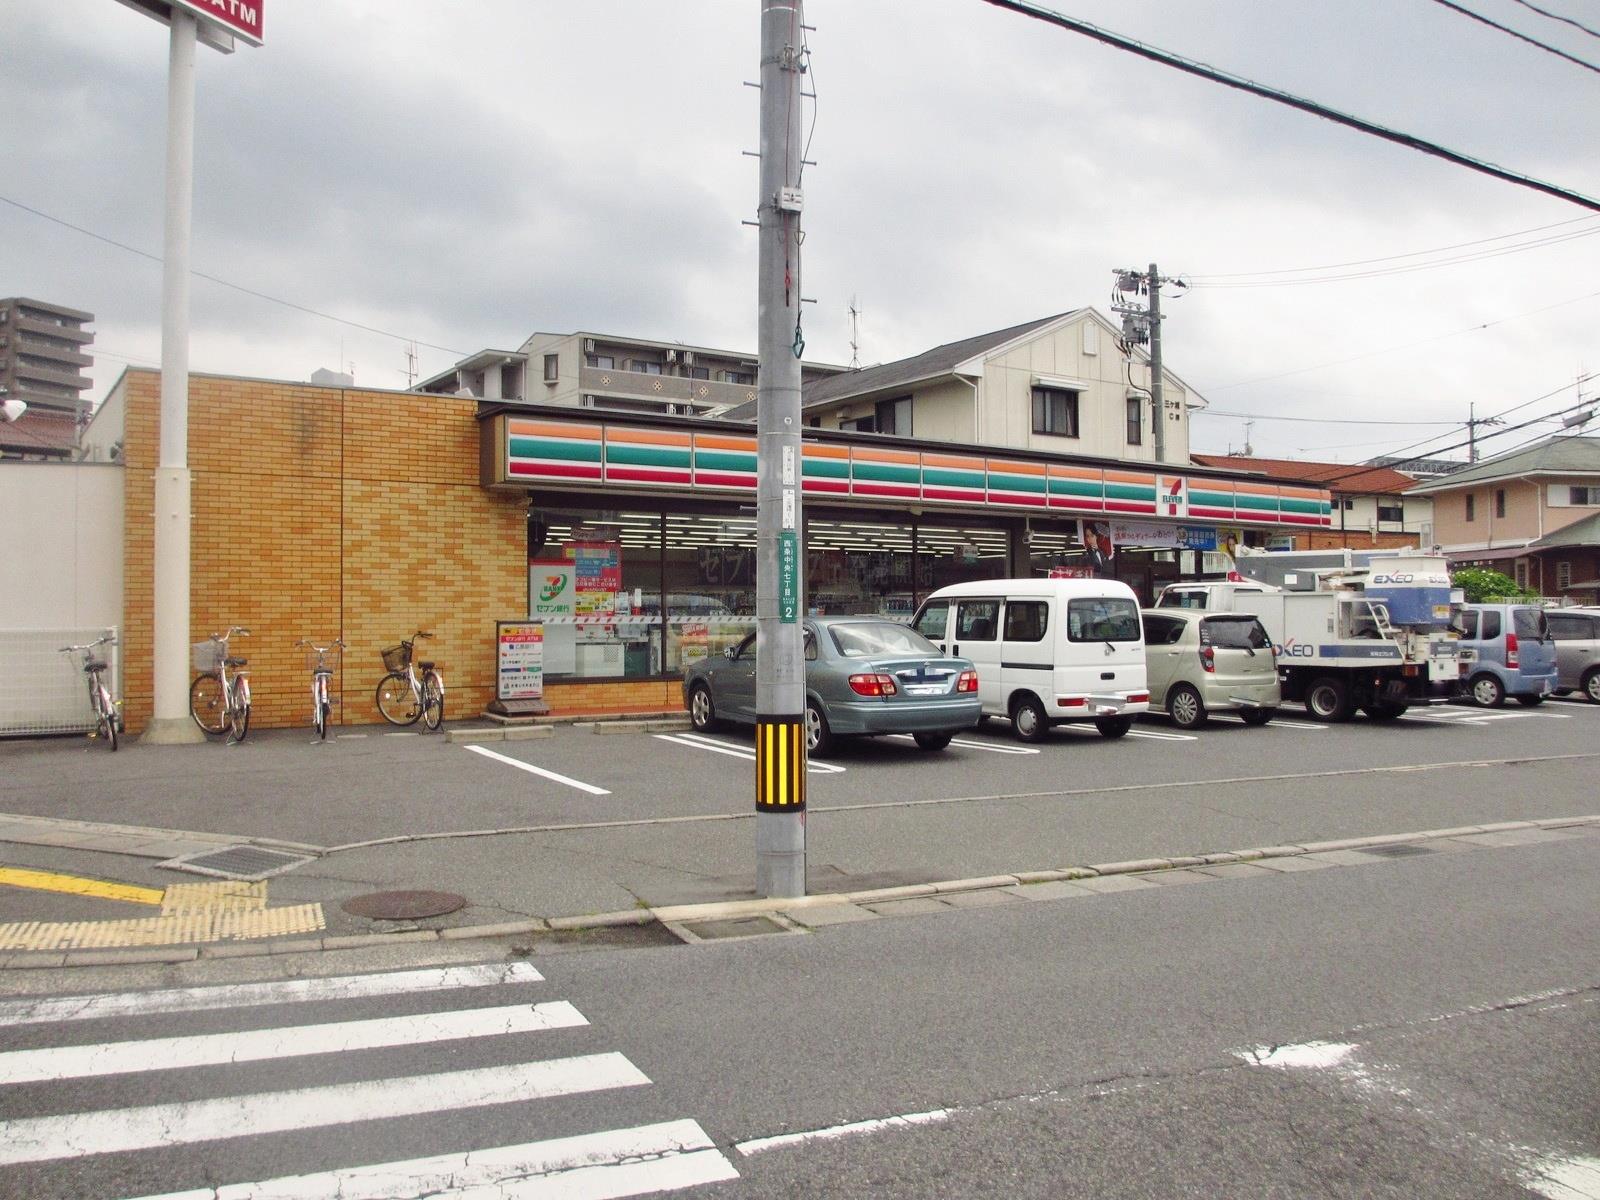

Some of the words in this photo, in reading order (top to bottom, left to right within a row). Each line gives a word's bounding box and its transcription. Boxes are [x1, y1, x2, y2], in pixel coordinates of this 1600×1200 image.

[783, 540, 791, 596] 西条中央七丁目
[1373, 571, 1414, 584] EXEO
[785, 607, 793, 618] 2
